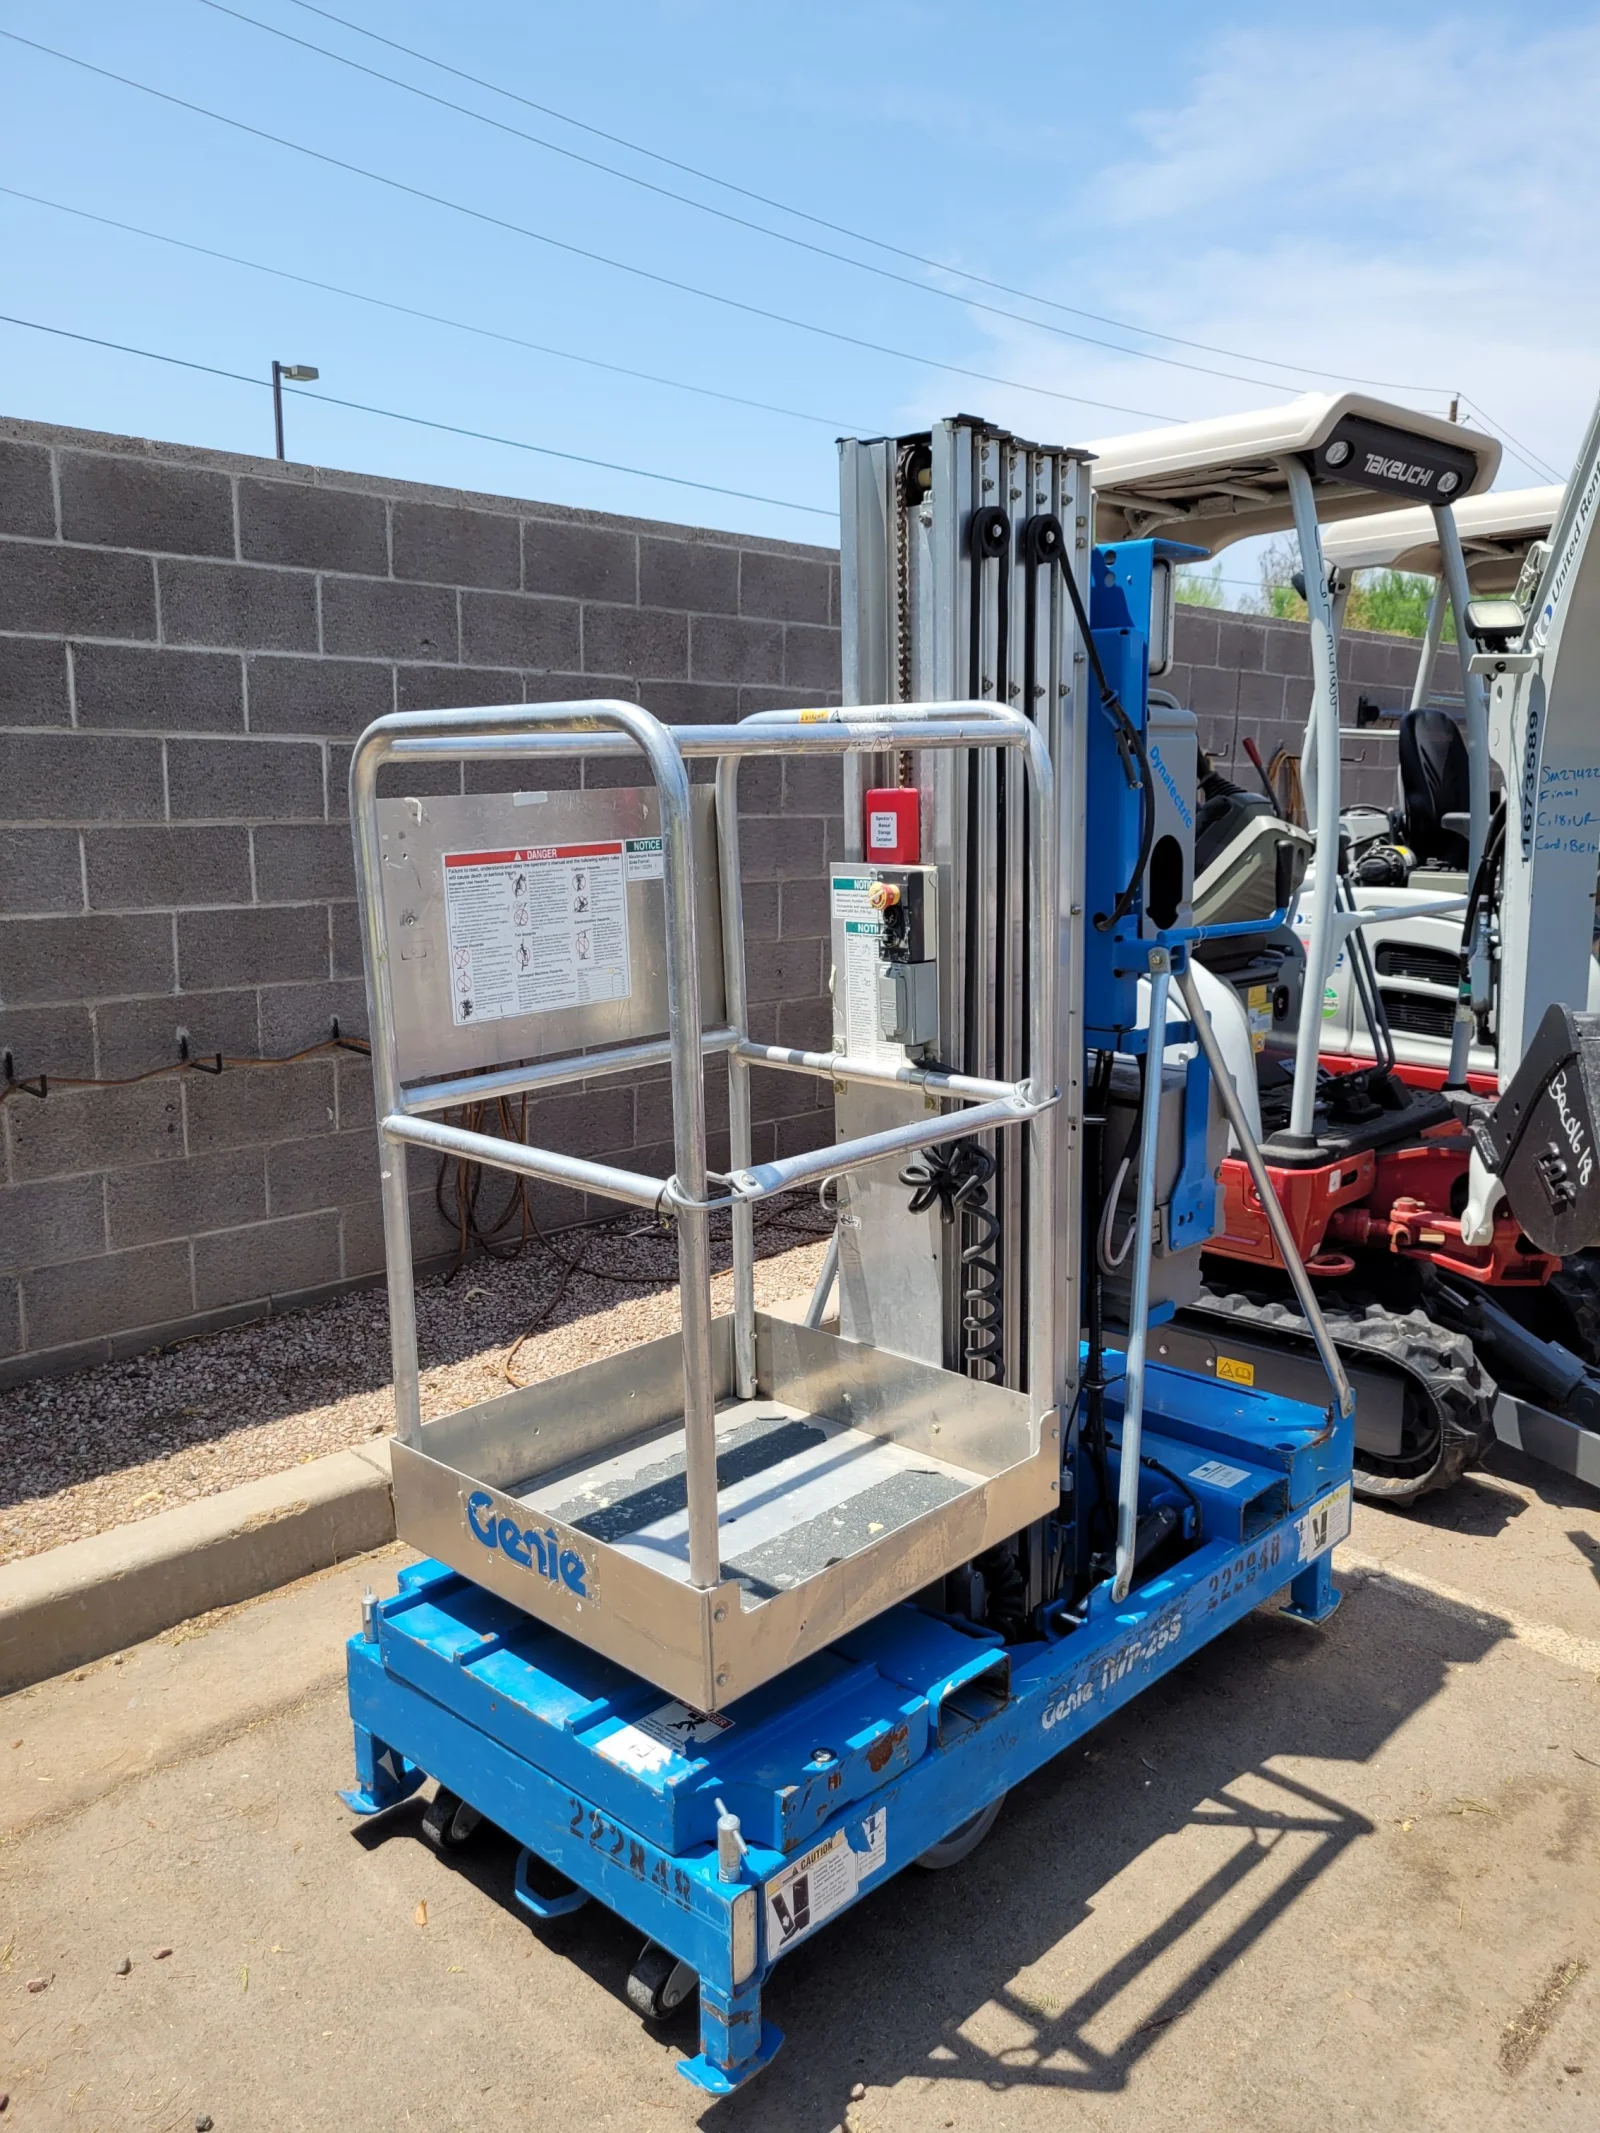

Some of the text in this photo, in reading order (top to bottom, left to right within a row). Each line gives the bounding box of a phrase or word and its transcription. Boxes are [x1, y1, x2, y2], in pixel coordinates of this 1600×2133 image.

[1364, 453, 1434, 487] TAKEUCHI
[1551, 520, 1581, 603] United
[1150, 745, 1194, 830] Dynalectric
[526, 848, 558, 860] DANGER
[633, 839, 661, 851] NOTICE
[857, 923, 879, 934] NOTI
[467, 1490, 587, 1599] Genie
[800, 1840, 834, 1871] CAUTION
